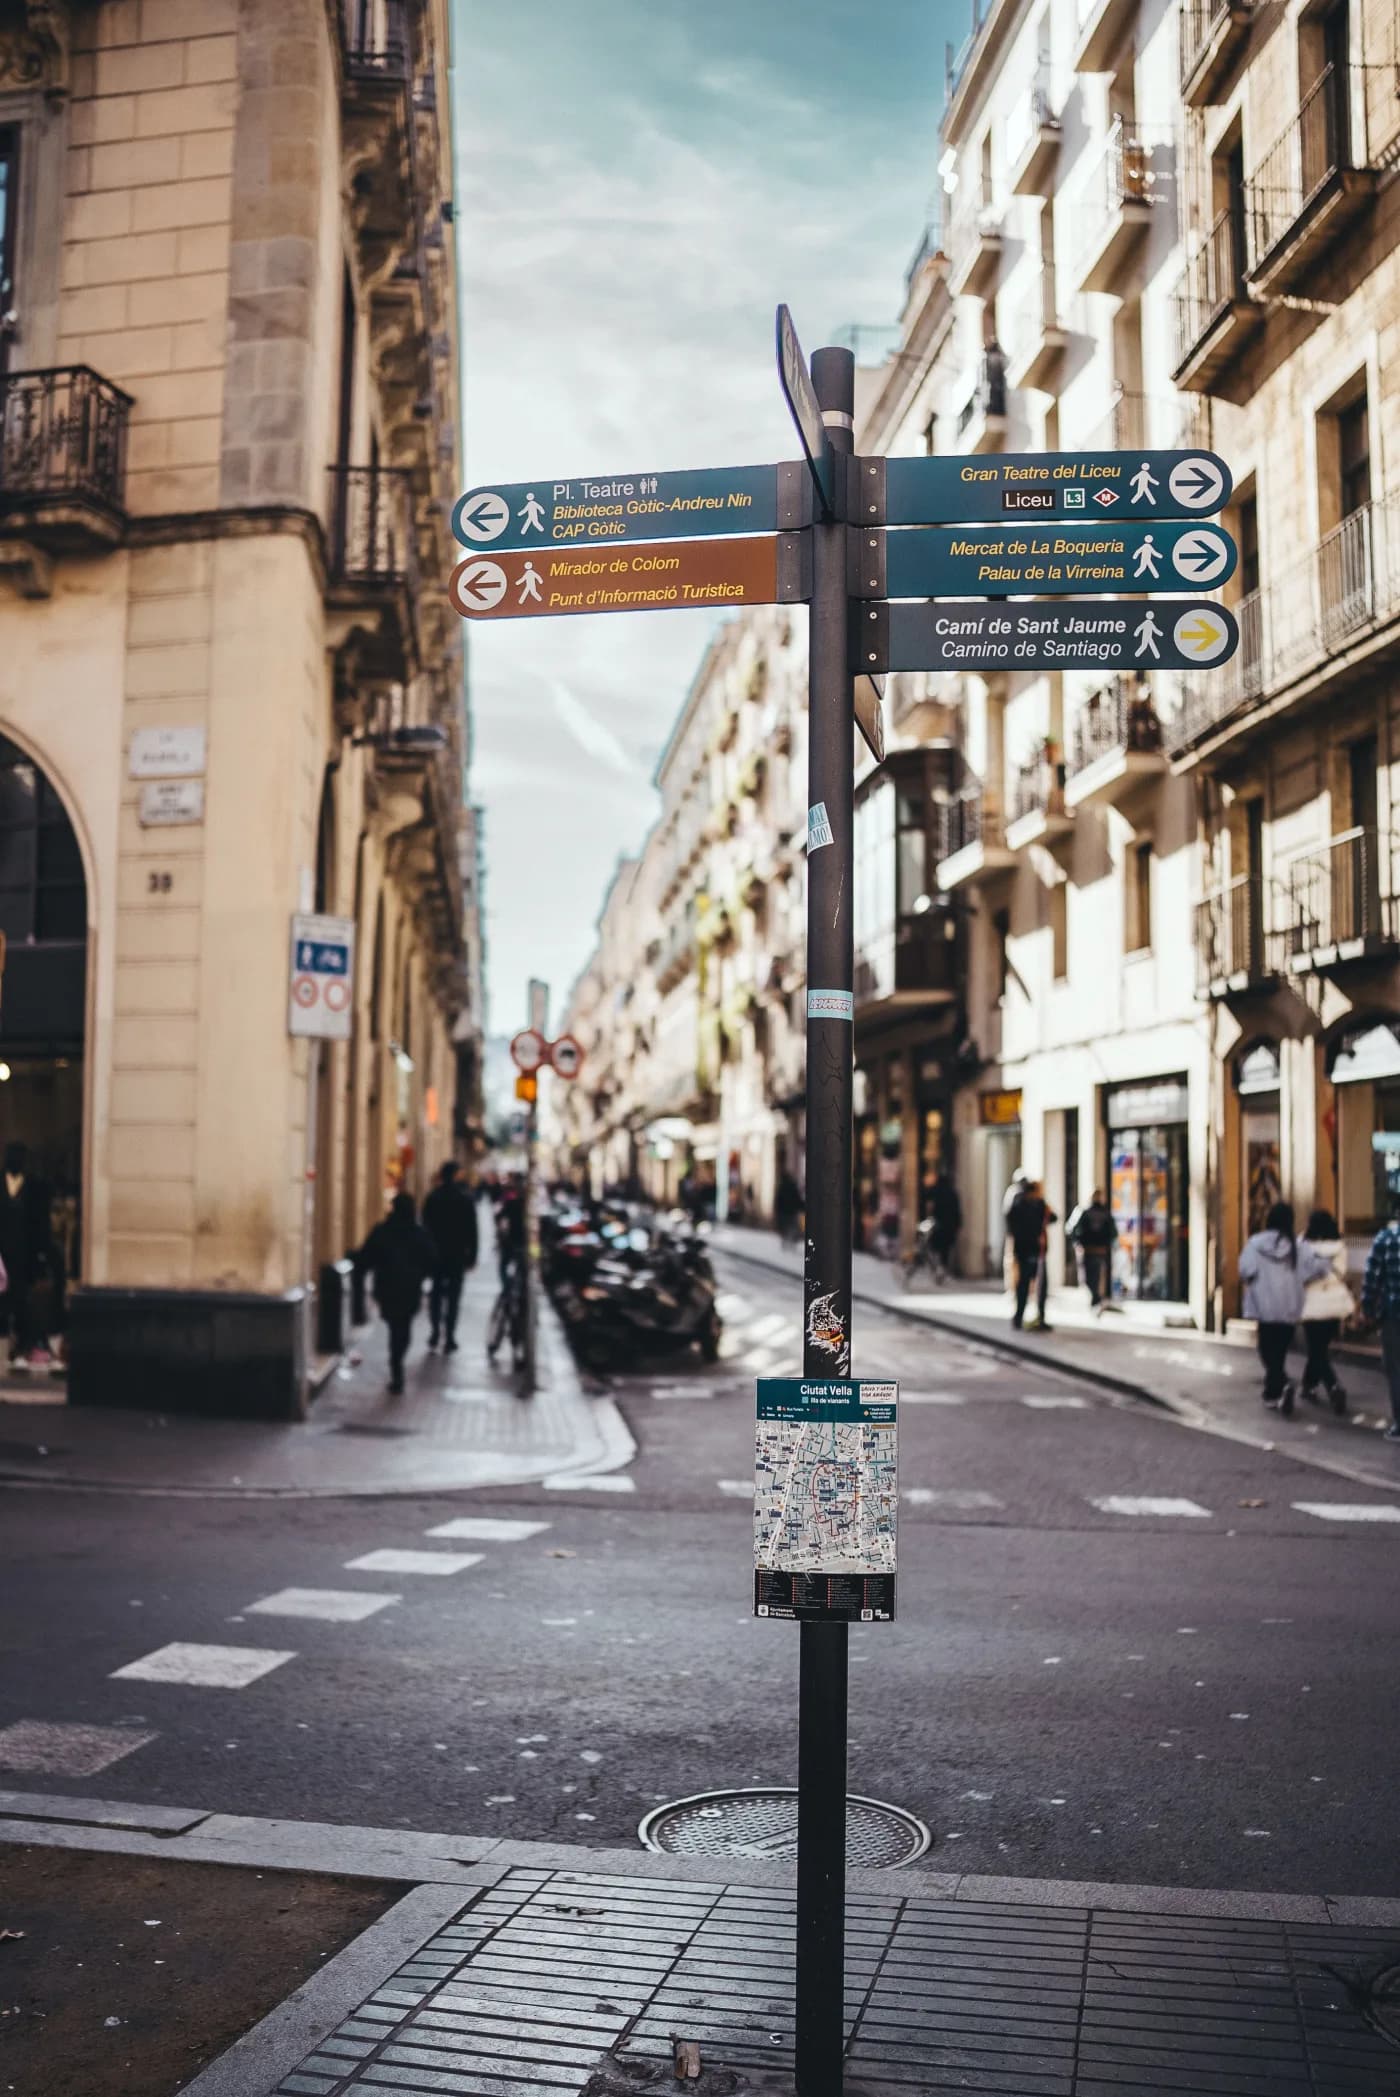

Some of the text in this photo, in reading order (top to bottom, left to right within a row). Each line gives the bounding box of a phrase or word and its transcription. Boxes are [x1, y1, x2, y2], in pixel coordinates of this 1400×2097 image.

[961, 464, 1121, 481] Gran Teatre del Liceu
[554, 482, 634, 500] Pl. Teatre
[553, 493, 751, 519] Biblioteca Gòtic-Andreu Nin
[1006, 493, 1111, 507] Liceu L3 M
[553, 521, 625, 538] CAP Gòtic
[950, 539, 1123, 556] Mercat de La Boqueria
[550, 557, 679, 576] Mirador de Colom
[979, 565, 1124, 580] Palau de la Virreina
[549, 592, 583, 606] Punt
[682, 583, 744, 598] Turística
[936, 618, 1126, 635] Camí de Sant Jaume
[942, 640, 1121, 660] Camino de Santiago
[800, 1384, 828, 1395] Ciutat
[830, 1385, 853, 1396] Vella
